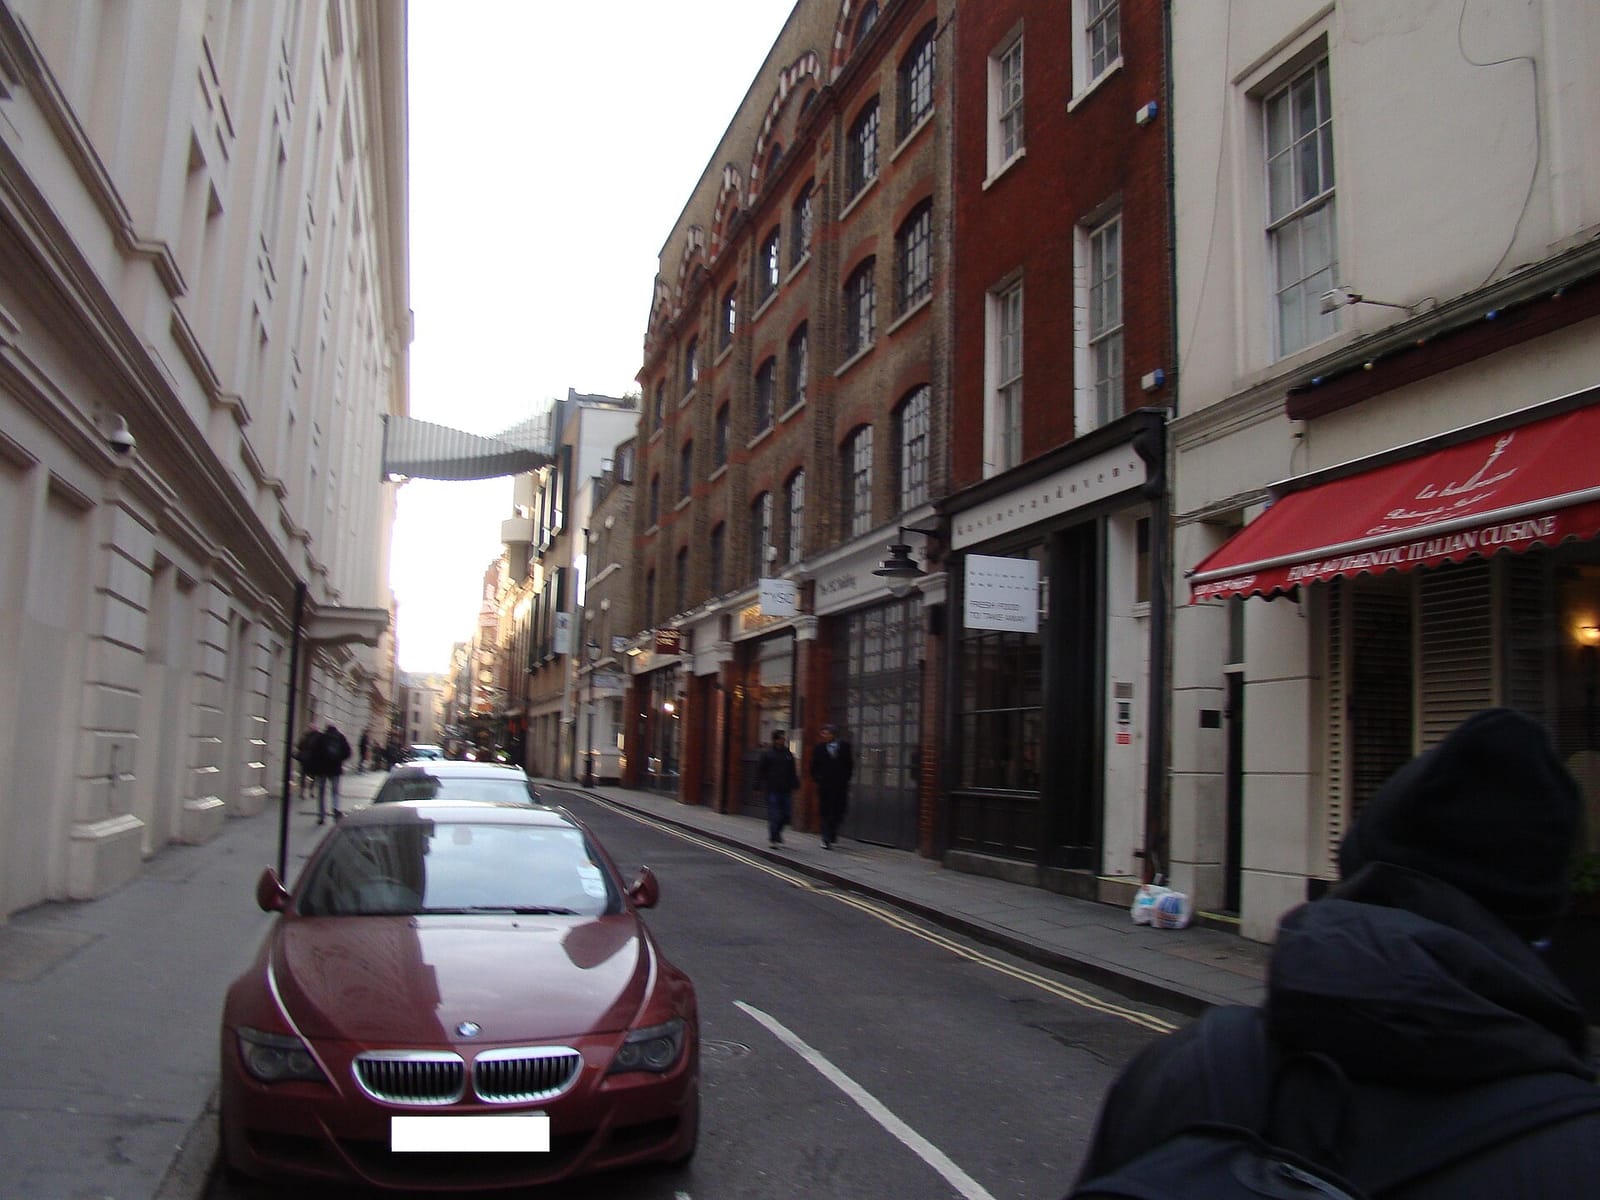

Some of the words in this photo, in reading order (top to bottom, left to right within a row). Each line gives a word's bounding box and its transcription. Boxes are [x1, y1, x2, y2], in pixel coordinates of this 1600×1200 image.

[1287, 562, 1321, 582] FINE
[1320, 545, 1410, 575] AUTHENTIC
[1407, 530, 1480, 561] ITALIAN
[1479, 514, 1559, 547] CUISINE
